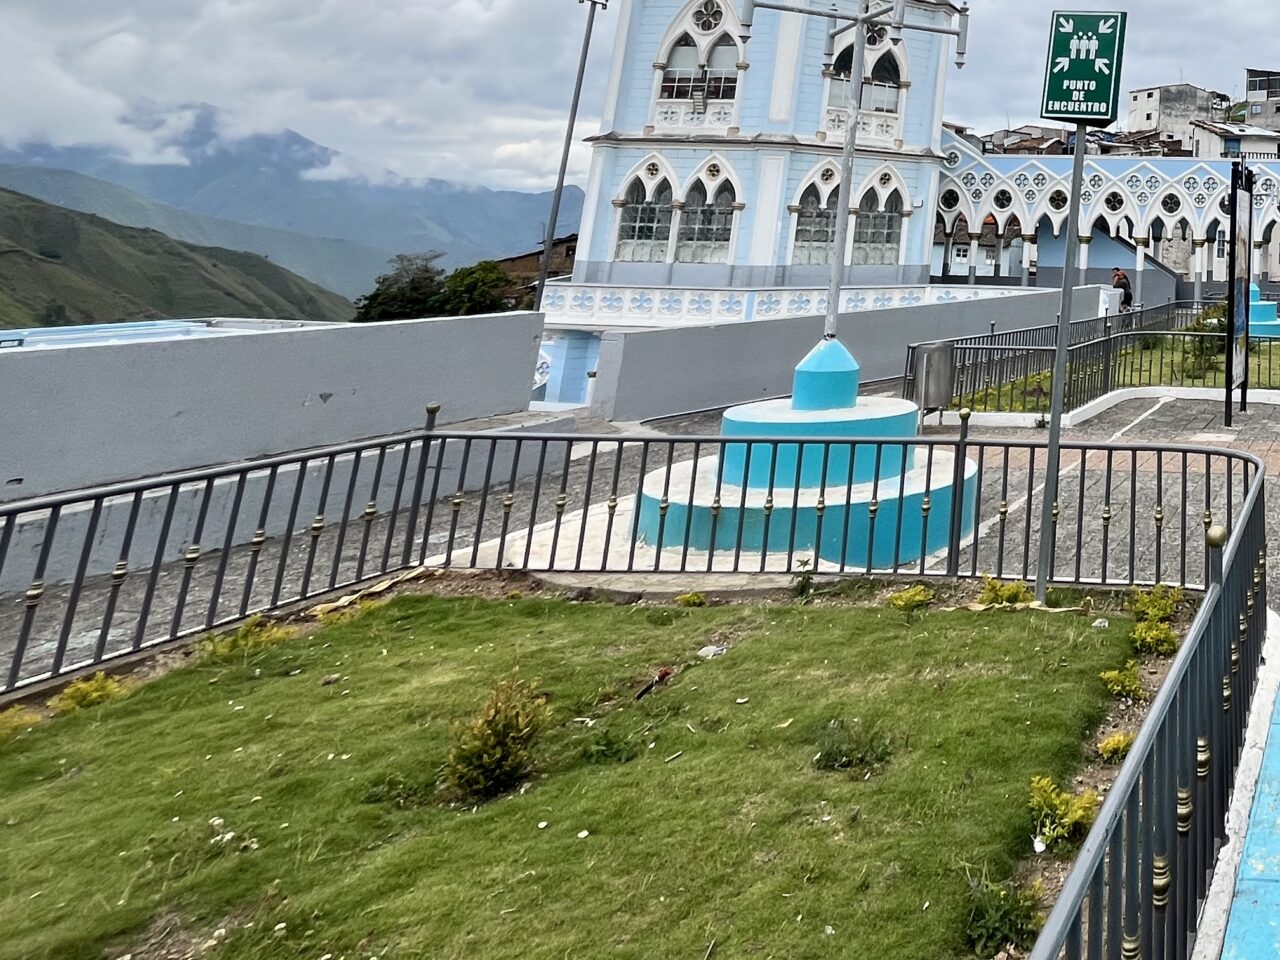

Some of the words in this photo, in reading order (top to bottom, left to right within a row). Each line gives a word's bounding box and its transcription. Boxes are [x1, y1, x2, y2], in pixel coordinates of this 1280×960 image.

[1063, 80, 1096, 91] PUNTO
[1072, 91, 1085, 101] DE
[1048, 101, 1107, 113] ENCUENTRO
